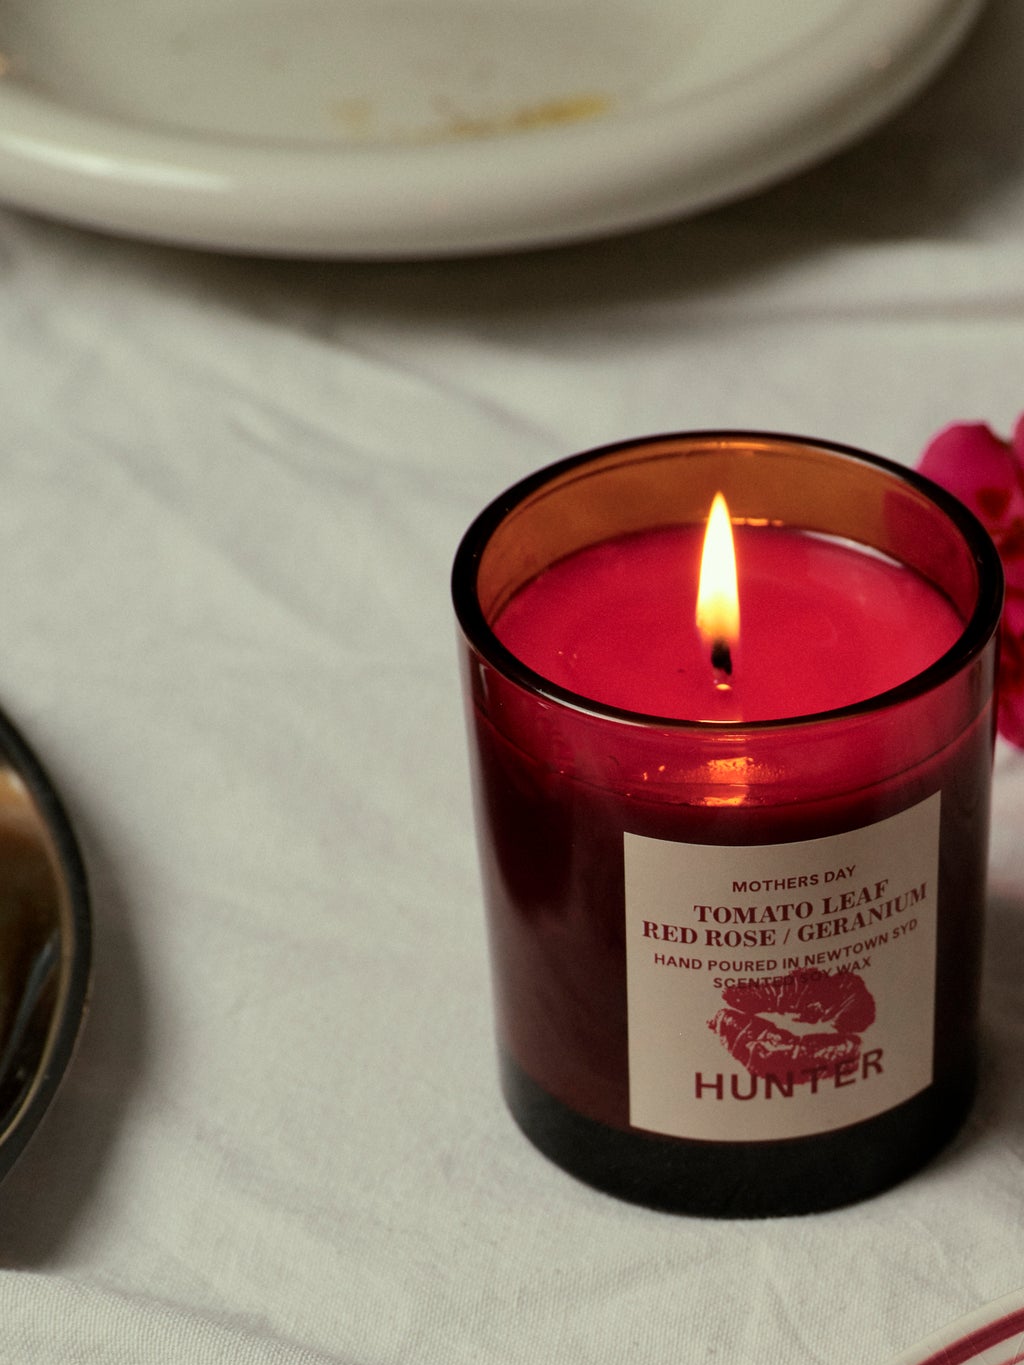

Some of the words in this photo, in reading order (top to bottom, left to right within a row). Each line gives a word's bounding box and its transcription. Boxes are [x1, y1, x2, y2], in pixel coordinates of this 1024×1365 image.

[693, 901, 813, 924] TOMATO
[821, 879, 889, 915] LEAF
[732, 874, 819, 893] MOTHERS
[824, 865, 857, 883] DAY
[641, 920, 698, 945] RED
[704, 929, 776, 948] ROSE
[783, 928, 791, 945] /
[798, 882, 928, 943] GERANIUM
[654, 953, 702, 970] HAND
[708, 960, 777, 972] POURED
[782, 957, 799, 970] IN
[804, 933, 889, 967] NEWTOWN
[892, 918, 918, 939] SYD
[713, 973, 795, 990] SCENTED
[836, 956, 872, 976] WAX
[695, 1048, 885, 1101] HUNTER
